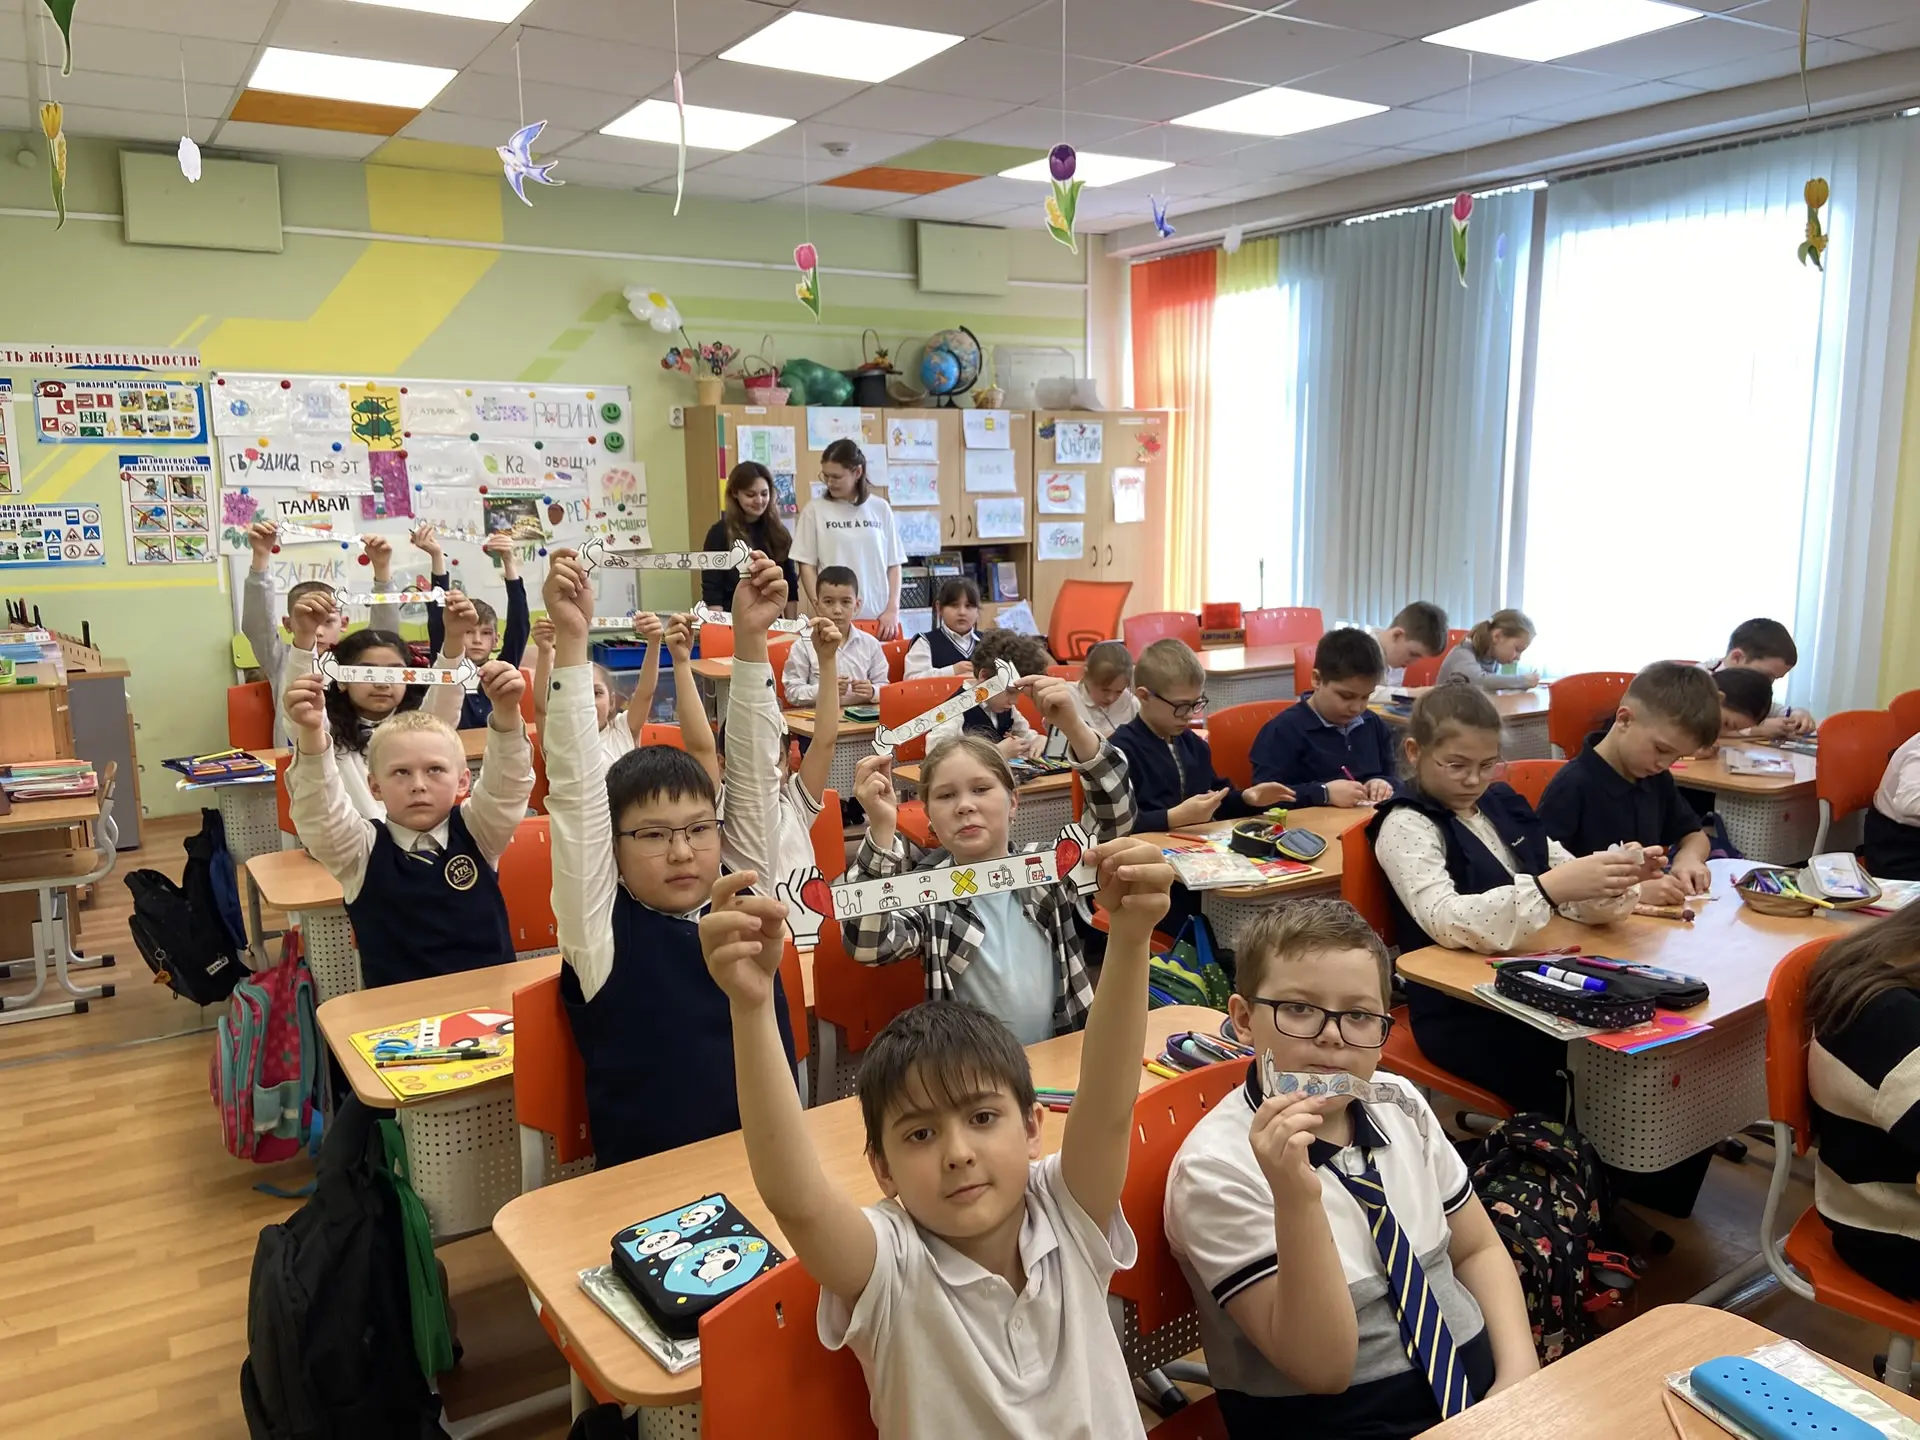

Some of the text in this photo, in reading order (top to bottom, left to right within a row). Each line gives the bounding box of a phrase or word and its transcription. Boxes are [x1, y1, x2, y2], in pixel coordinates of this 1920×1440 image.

[29, 351, 199, 367] ЖИЗНЕДЕЯТЕЛЬНОСТИ
[117, 382, 167, 390] БЕЗОПАСНОСТЬ
[278, 494, 351, 514] ТАМВАЙ
[825, 521, 852, 529] FOLIE
[454, 865, 469, 877] 170
